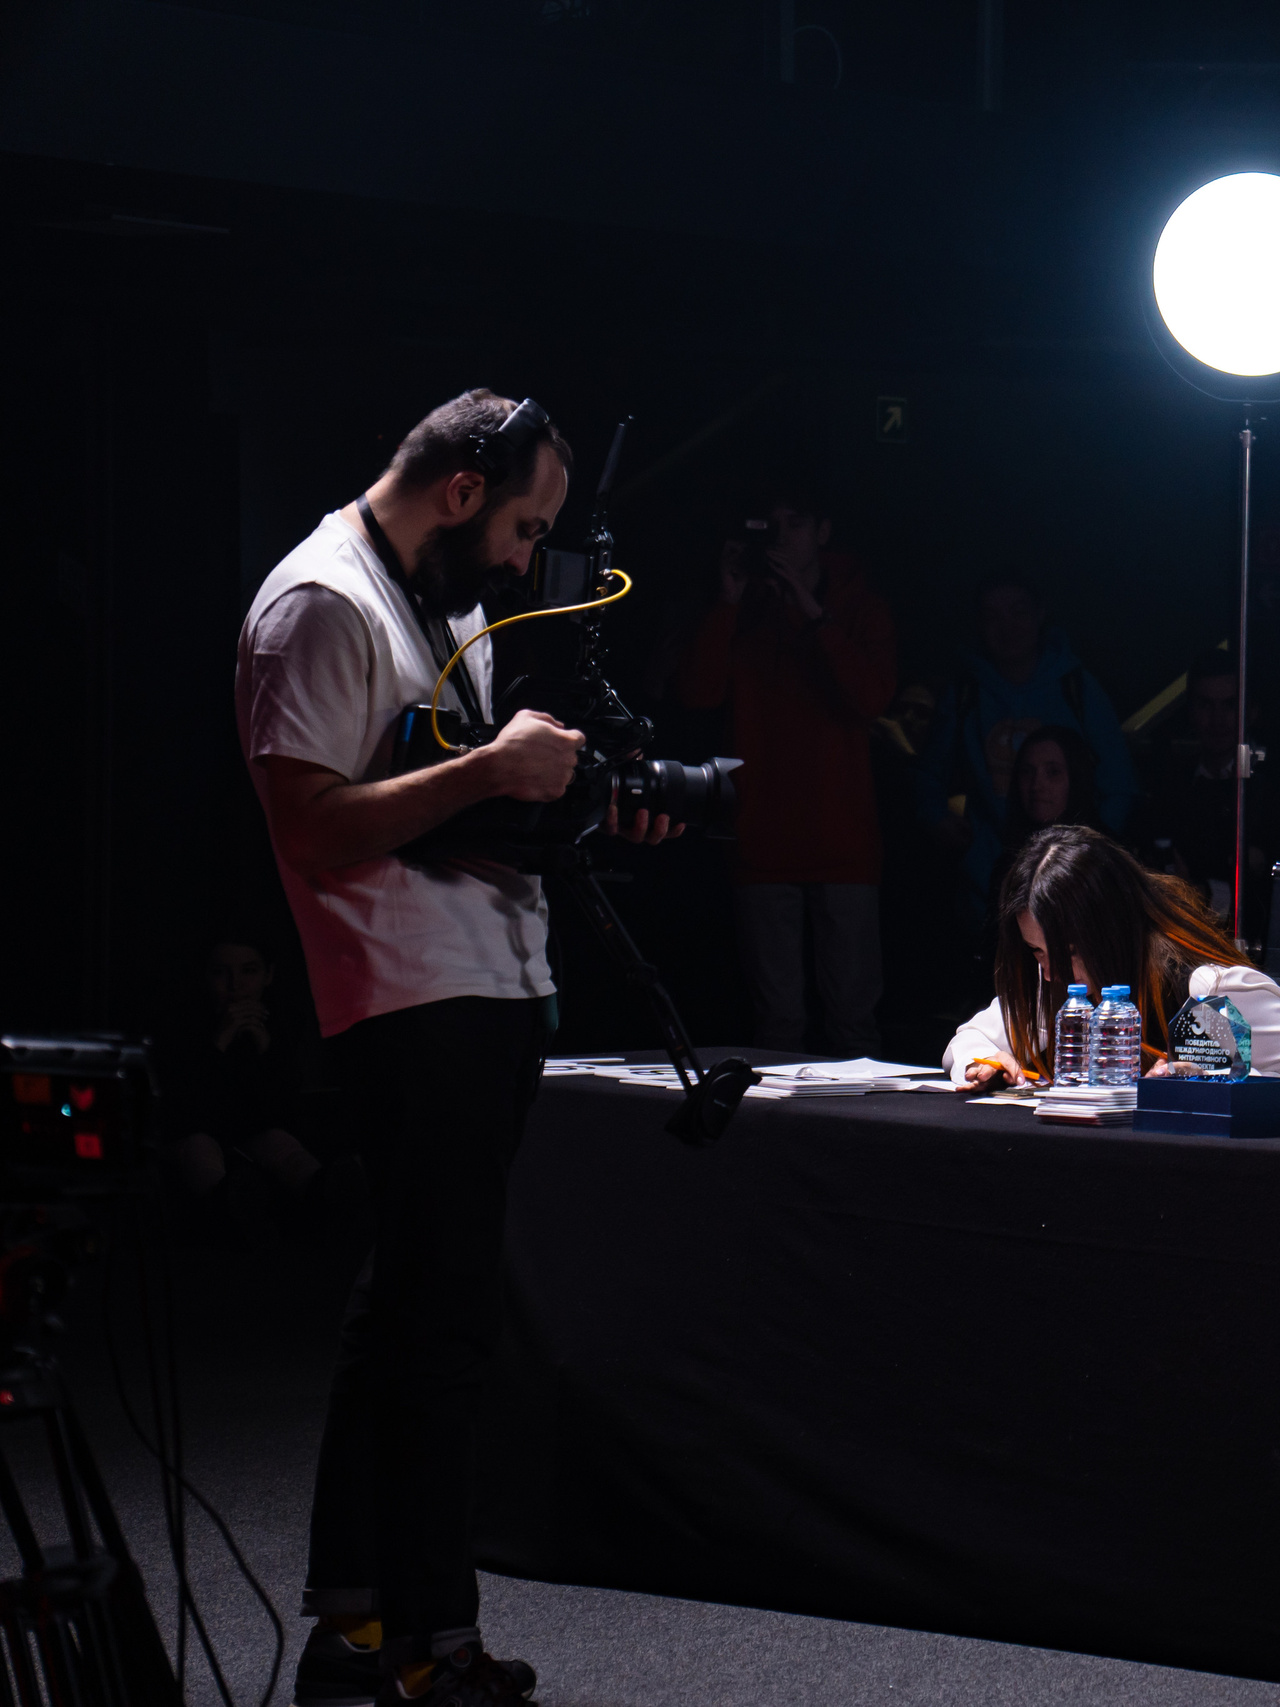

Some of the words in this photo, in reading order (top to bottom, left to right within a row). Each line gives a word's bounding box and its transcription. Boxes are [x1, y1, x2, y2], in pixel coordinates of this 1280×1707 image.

[1191, 1010, 1205, 1035] 3
[1185, 1039, 1220, 1047] ПОБЕДИТЕЛЬ
[1175, 1046, 1230, 1056] МЕЖДУНАРОДНОГО
[1178, 1054, 1227, 1063] ИНТЕРАКТИВНОГО
